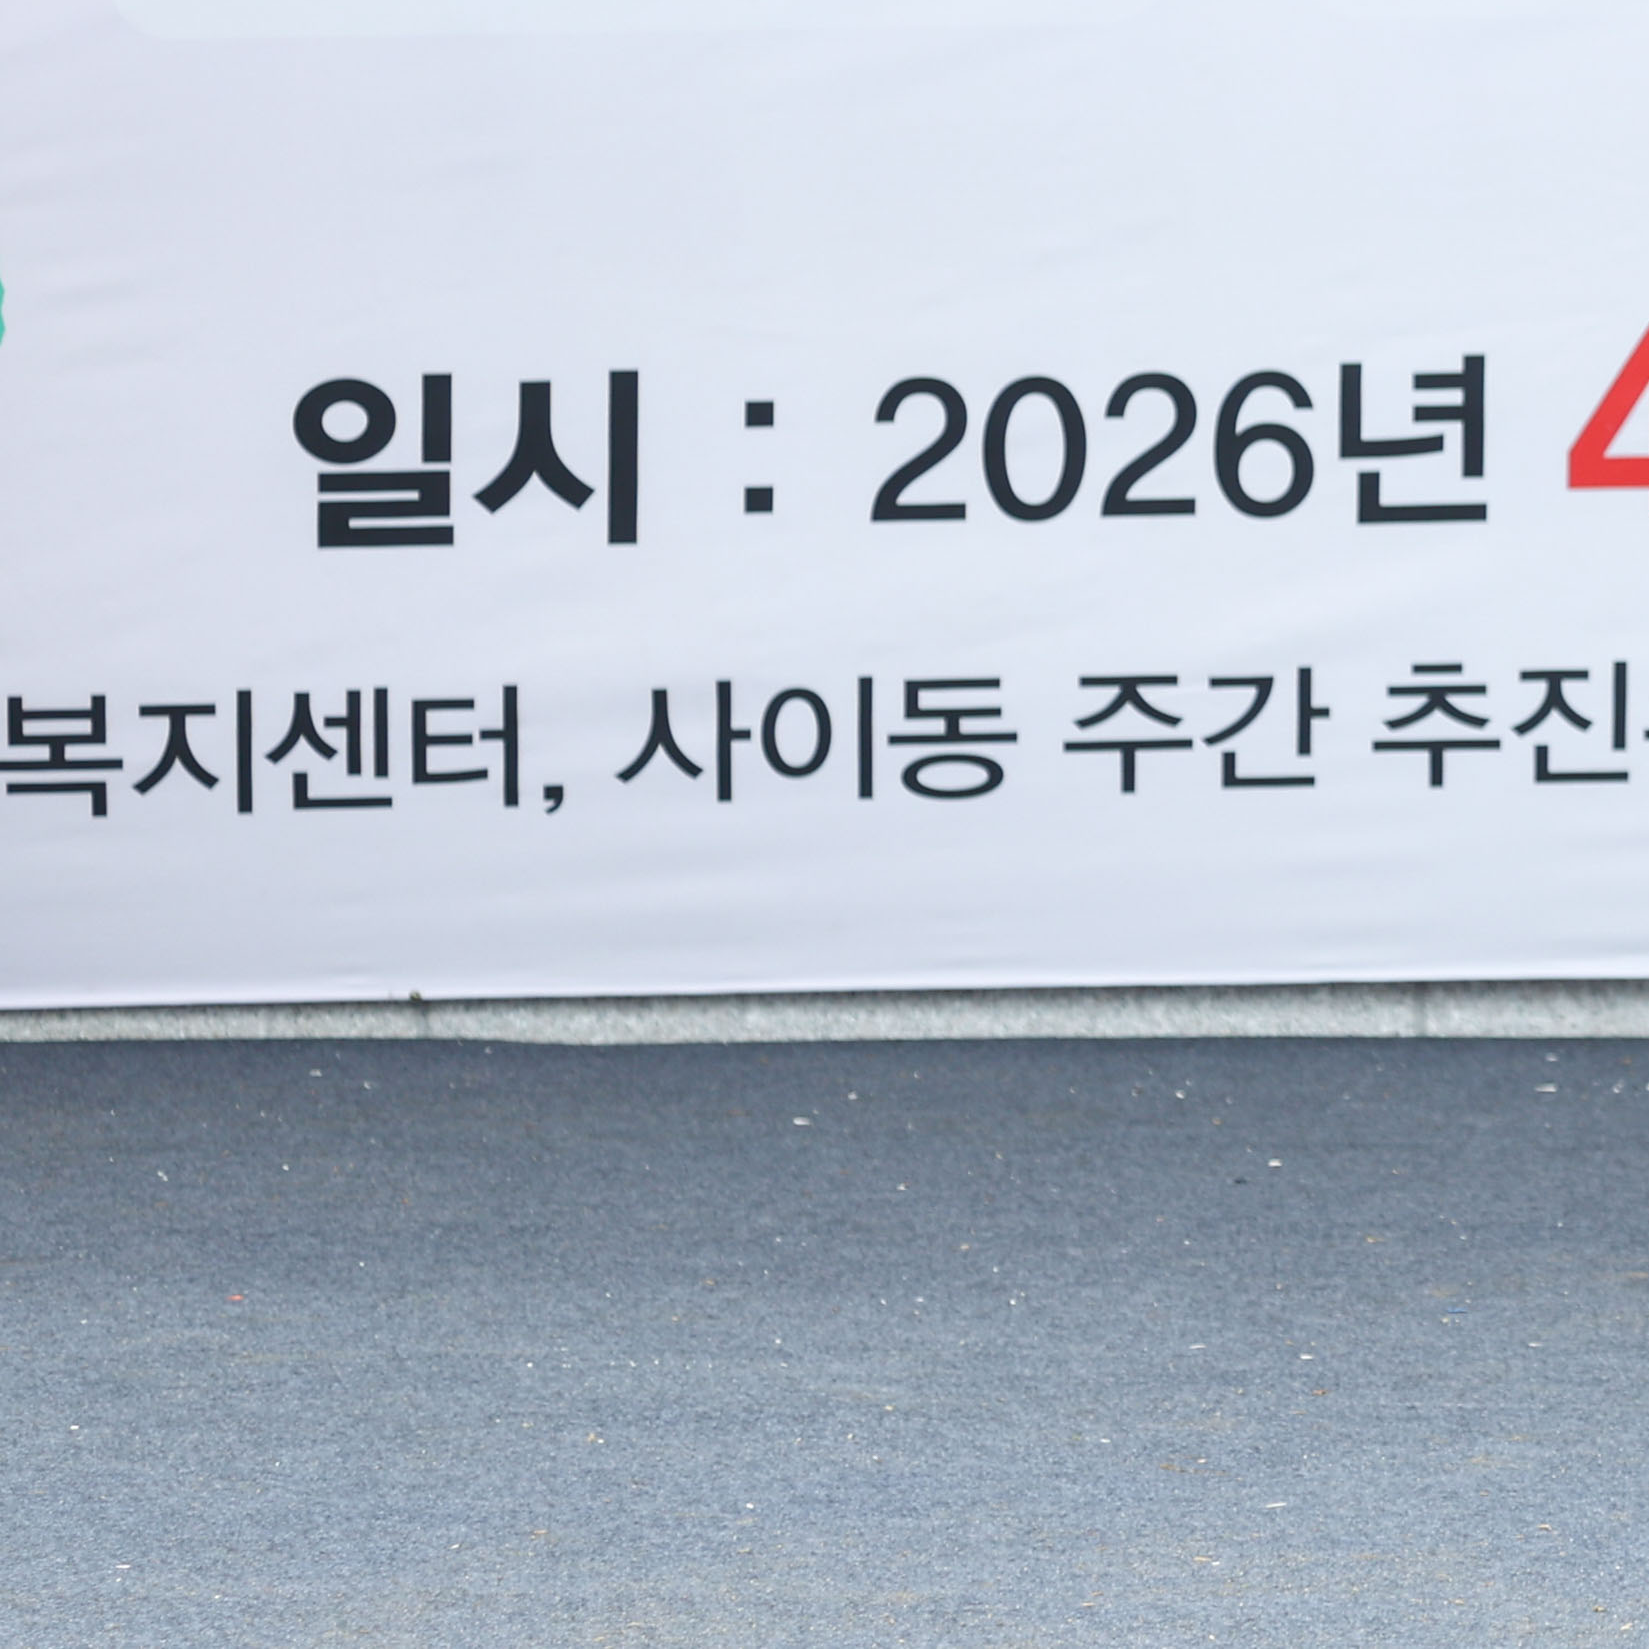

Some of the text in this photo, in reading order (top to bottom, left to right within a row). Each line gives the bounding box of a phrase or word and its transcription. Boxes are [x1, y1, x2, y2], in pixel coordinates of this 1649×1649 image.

[294, 370, 638, 547] 일시
[744, 401, 774, 513] :
[871, 355, 1487, 524] 2026년
[0, 685, 565, 817] 복지센터,
[617, 677, 1018, 802] 사이동
[1064, 667, 1330, 793] 주간
